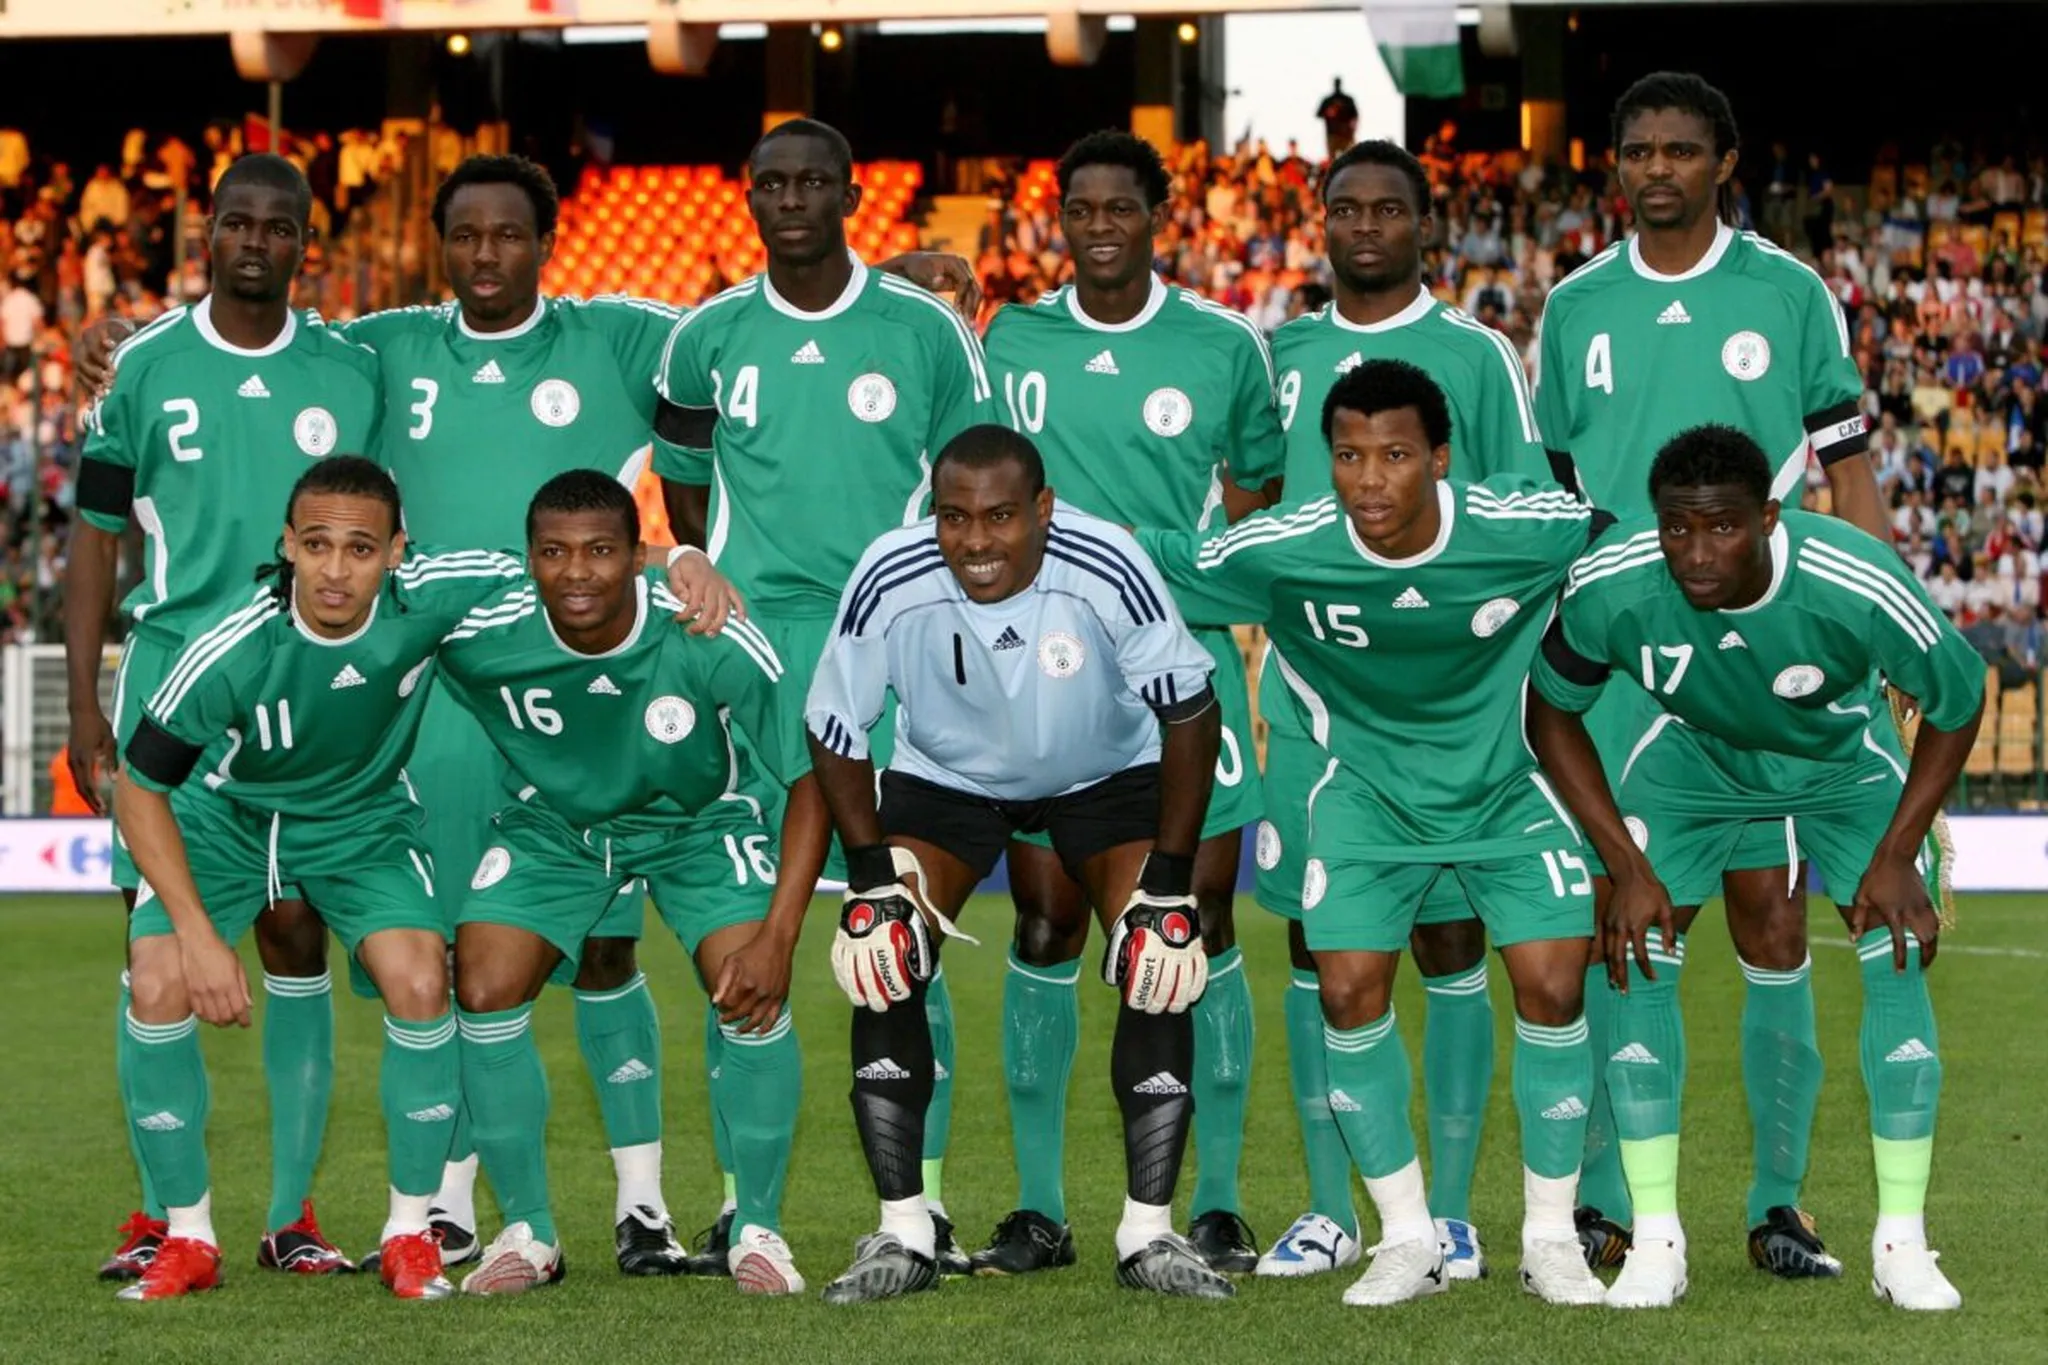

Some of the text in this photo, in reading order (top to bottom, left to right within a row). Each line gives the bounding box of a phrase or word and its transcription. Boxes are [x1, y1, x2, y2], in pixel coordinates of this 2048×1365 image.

[1585, 333, 1612, 395] 4
[409, 378, 438, 439] 3
[1004, 371, 1047, 434] 10
[1280, 370, 1301, 432] 9
[162, 398, 203, 461] 2
[991, 638, 1025, 652] adidas
[1303, 600, 1370, 649] 15
[953, 632, 966, 687] 1
[1640, 644, 1694, 696] 17
[256, 698, 292, 751] 11
[497, 685, 563, 736] 16
[723, 834, 778, 886] 16
[1541, 848, 1592, 898] 15
[855, 1069, 910, 1081] adidas
[1132, 1083, 1188, 1095] adidas
